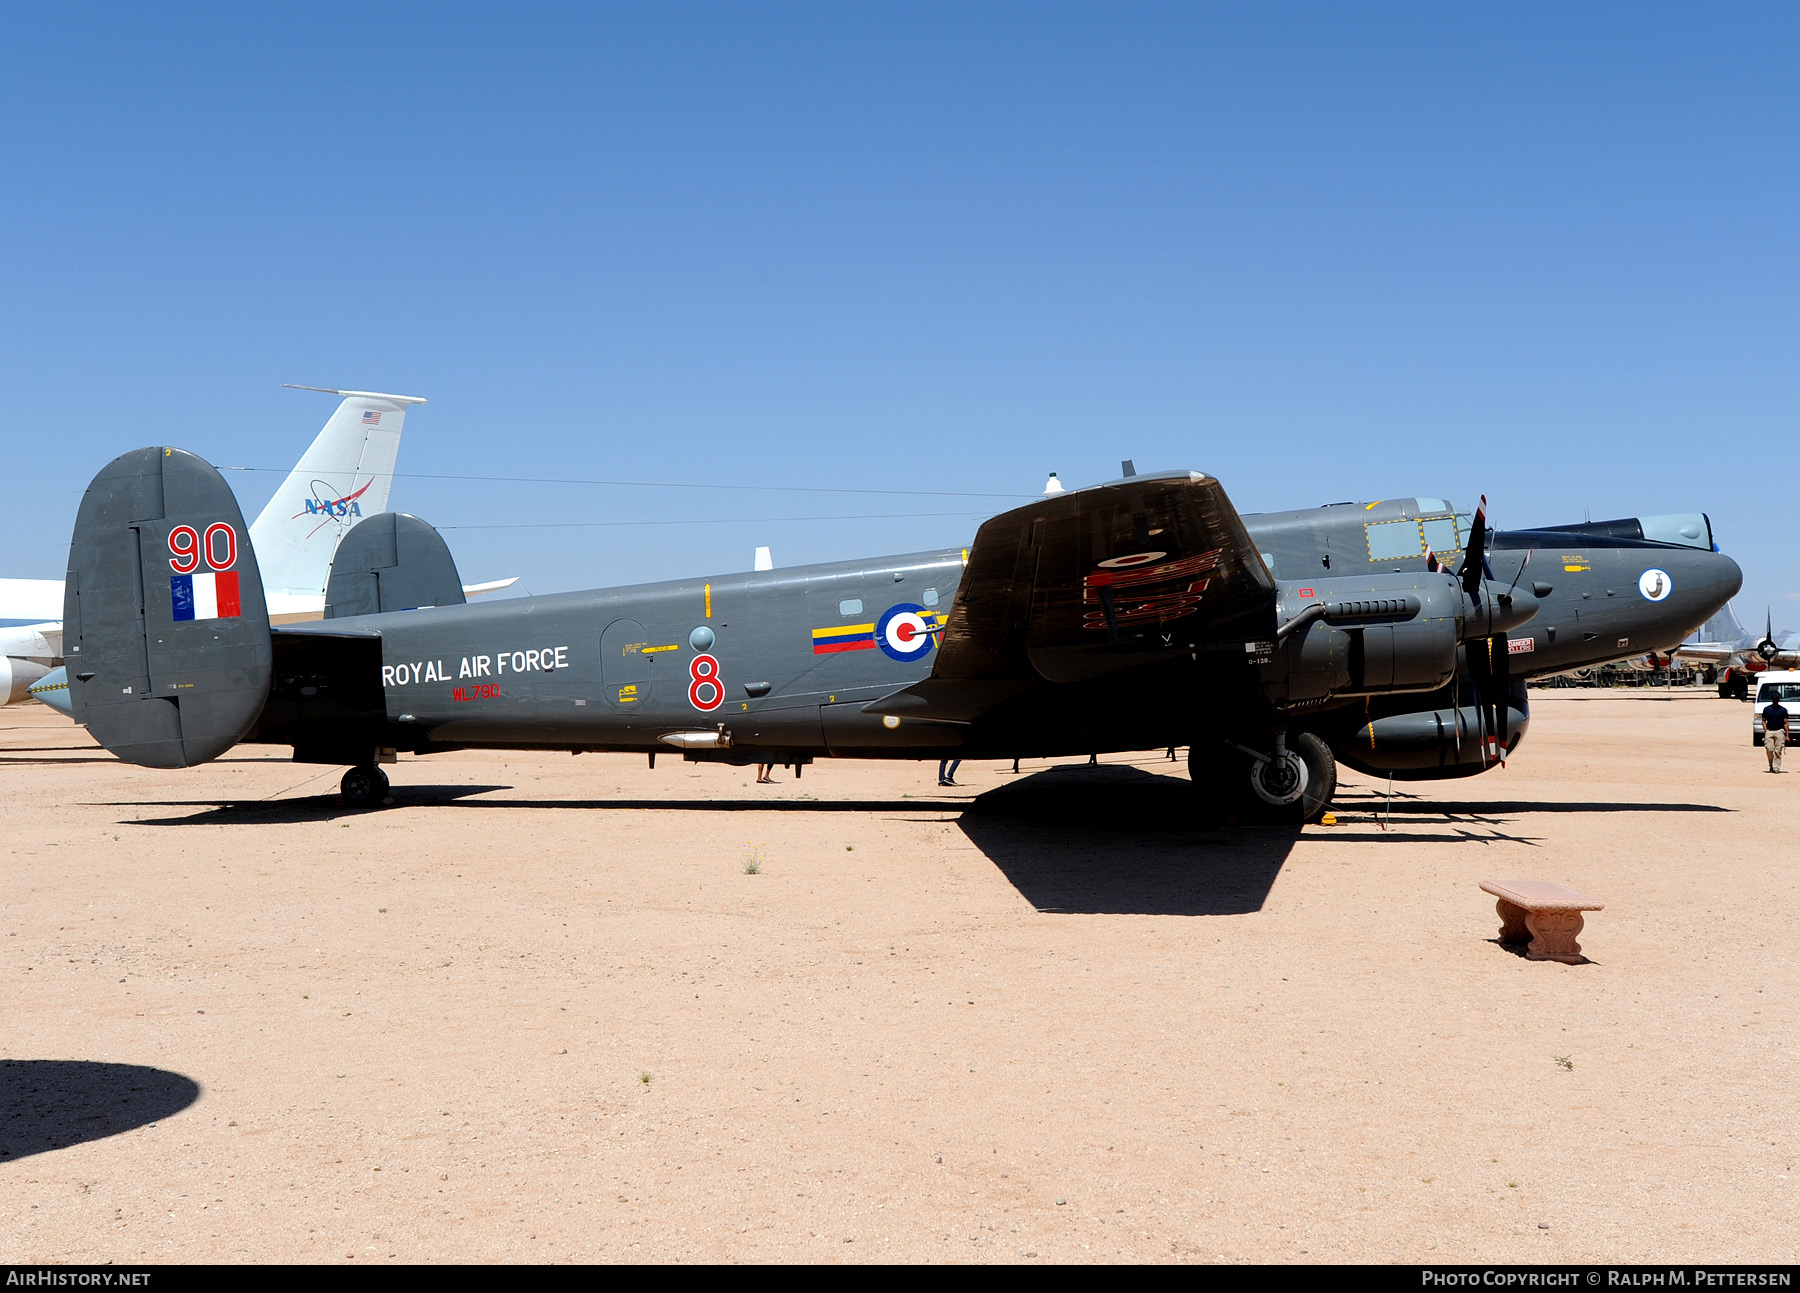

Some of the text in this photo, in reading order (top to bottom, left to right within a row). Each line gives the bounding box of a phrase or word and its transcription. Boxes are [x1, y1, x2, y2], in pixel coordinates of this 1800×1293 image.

[165, 448, 171, 457] 2
[304, 498, 363, 517] NASA
[167, 521, 238, 574] 90
[382, 646, 569, 687] ROYAL AIR FORCE
[687, 653, 727, 713] 8
[453, 683, 501, 703] WL790
[829, 695, 836, 703] 2
[741, 703, 748, 711] 2
